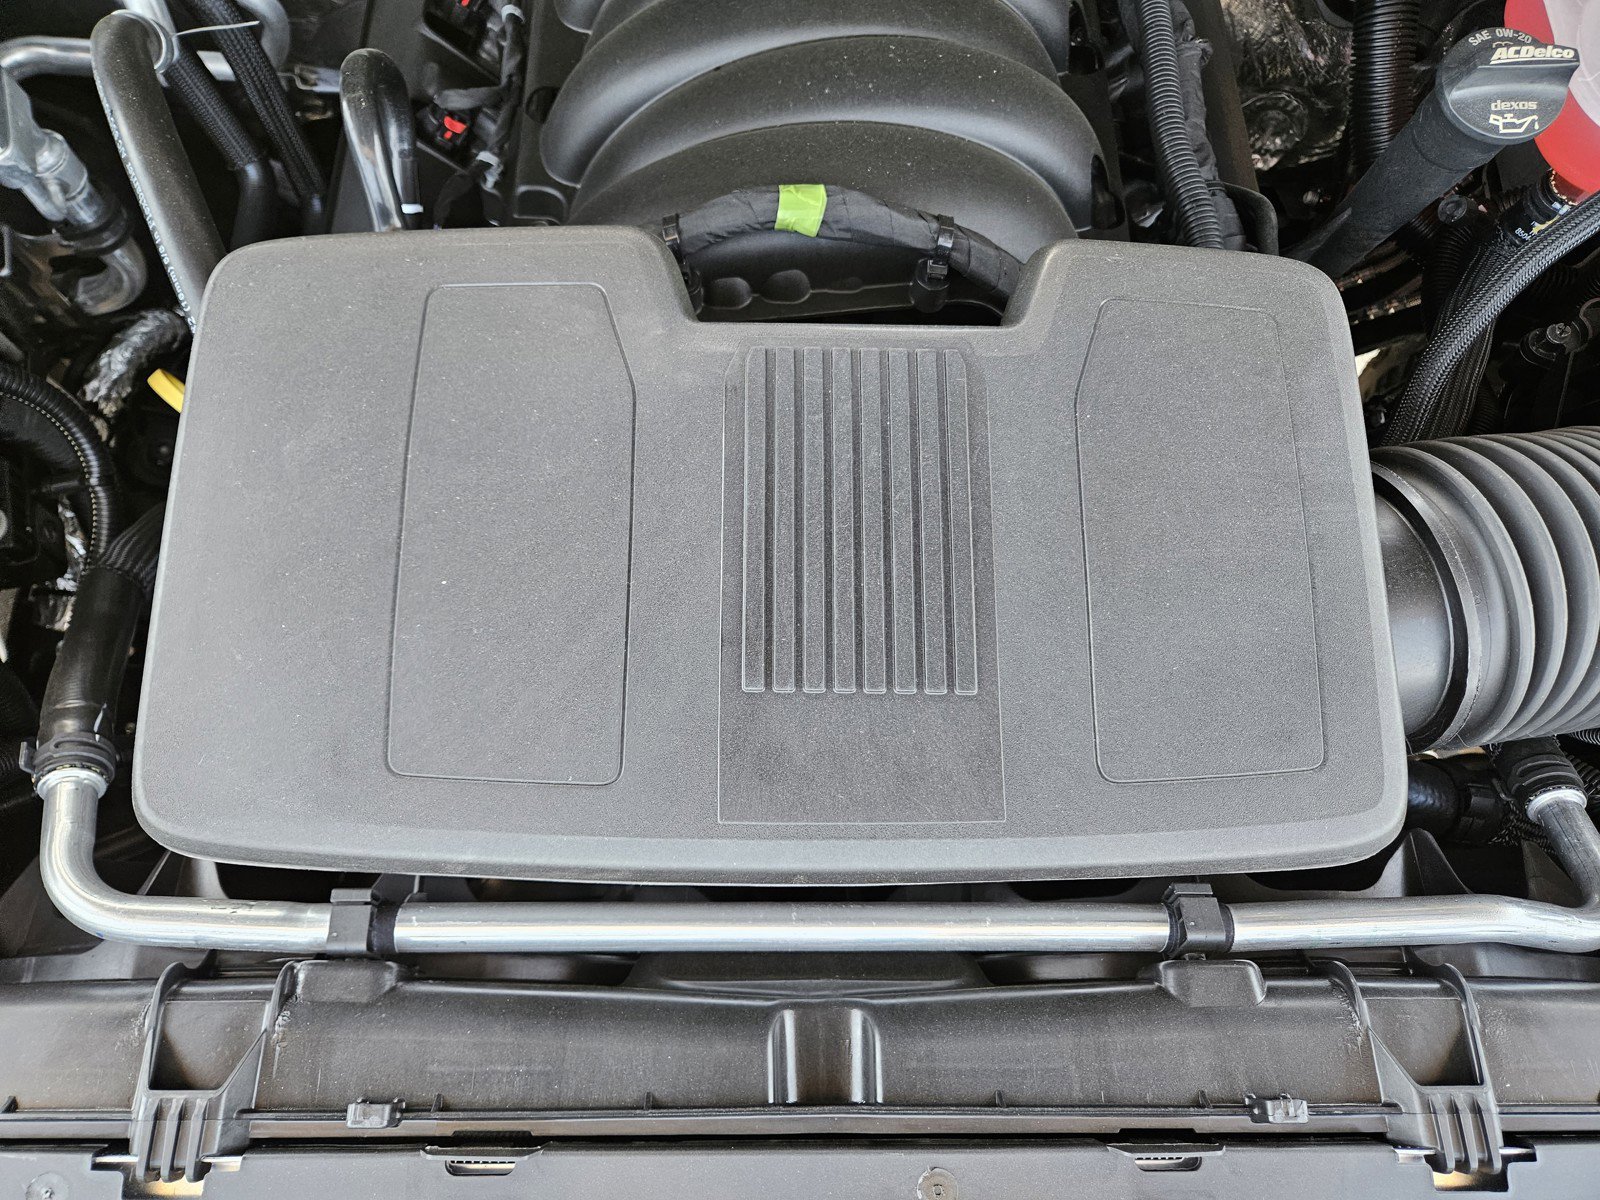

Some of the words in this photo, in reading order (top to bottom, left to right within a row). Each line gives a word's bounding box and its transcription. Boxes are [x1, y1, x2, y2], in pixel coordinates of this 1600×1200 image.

[1468, 30, 1492, 46] SAE
[1496, 28, 1532, 44] 0W-20
[1490, 45, 1575, 61] ACDelco
[1490, 99, 1538, 111] dexos
